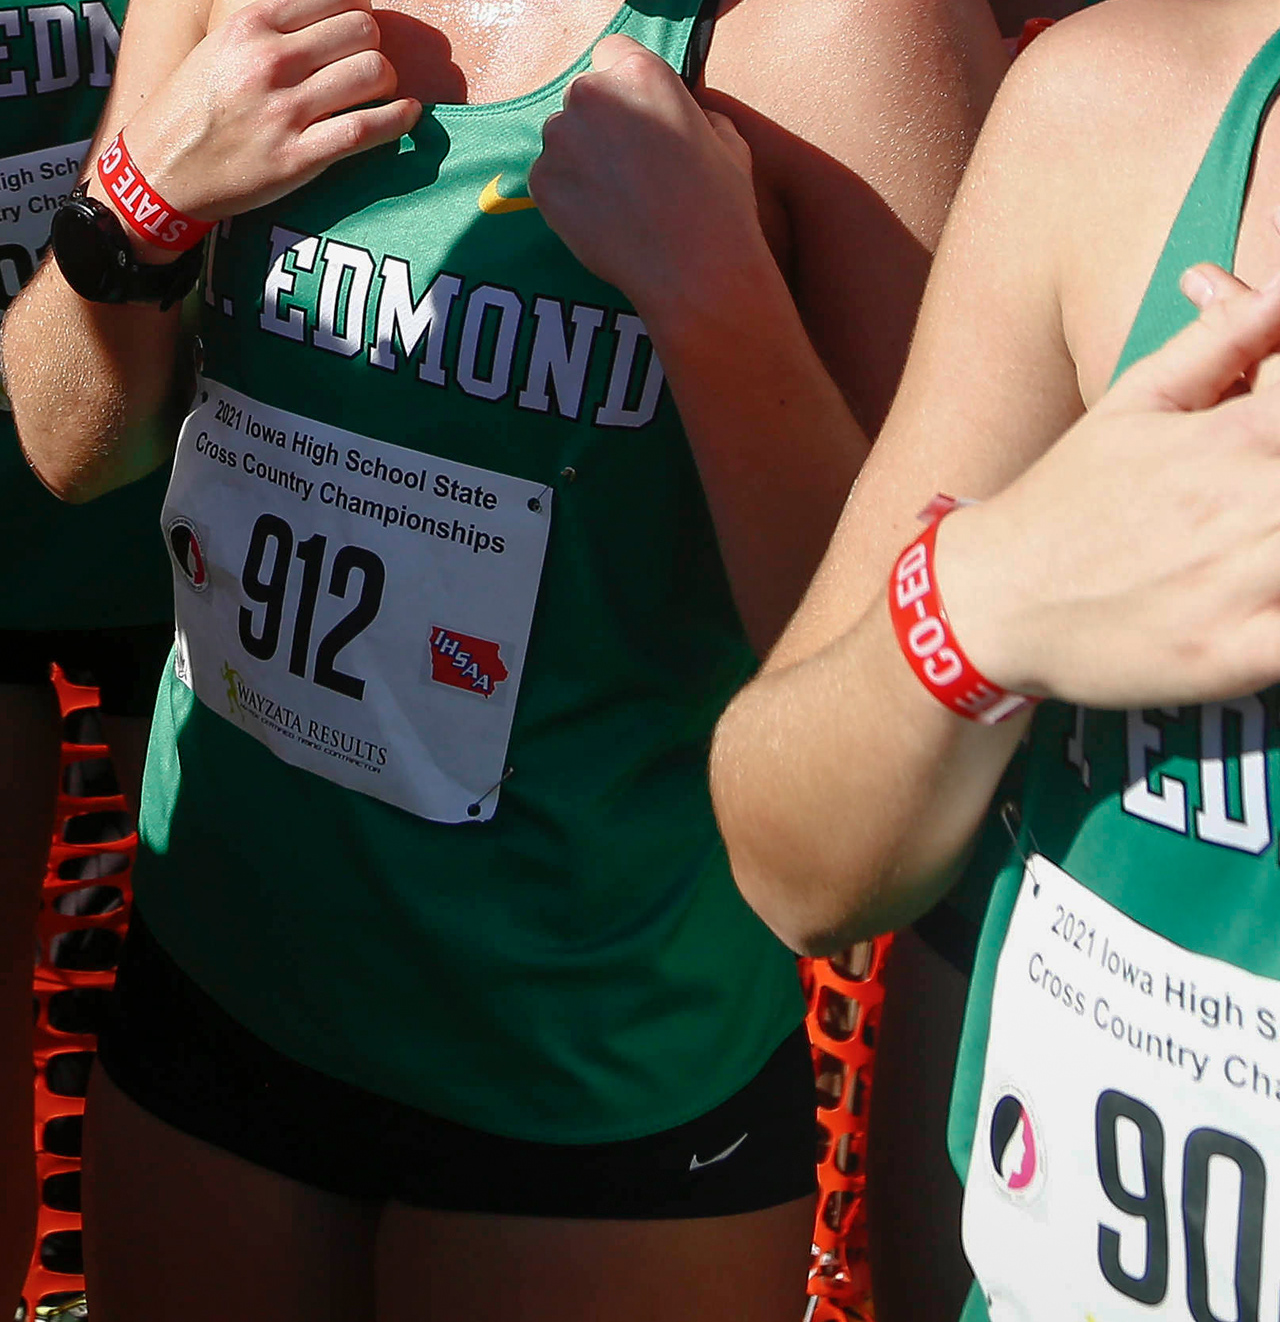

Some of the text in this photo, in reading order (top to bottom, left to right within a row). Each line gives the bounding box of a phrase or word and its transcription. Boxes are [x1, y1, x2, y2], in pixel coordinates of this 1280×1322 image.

[111, 165, 189, 244] STATE
[260, 224, 667, 431] EDMOND
[195, 431, 506, 556] Cross Country Championships
[215, 399, 499, 511] 2021 Iowa High School State
[236, 513, 387, 702] 912
[434, 630, 489, 691] IHSAA
[895, 541, 964, 688] CO-ED
[237, 681, 388, 767] WAYZATA RESULTS
[1028, 949, 1087, 1018] Cross
[1094, 1001, 1212, 1081] Country
[1050, 904, 1097, 960] 2021
[1100, 938, 1155, 997] Iowa
[1165, 973, 1246, 1031] High
